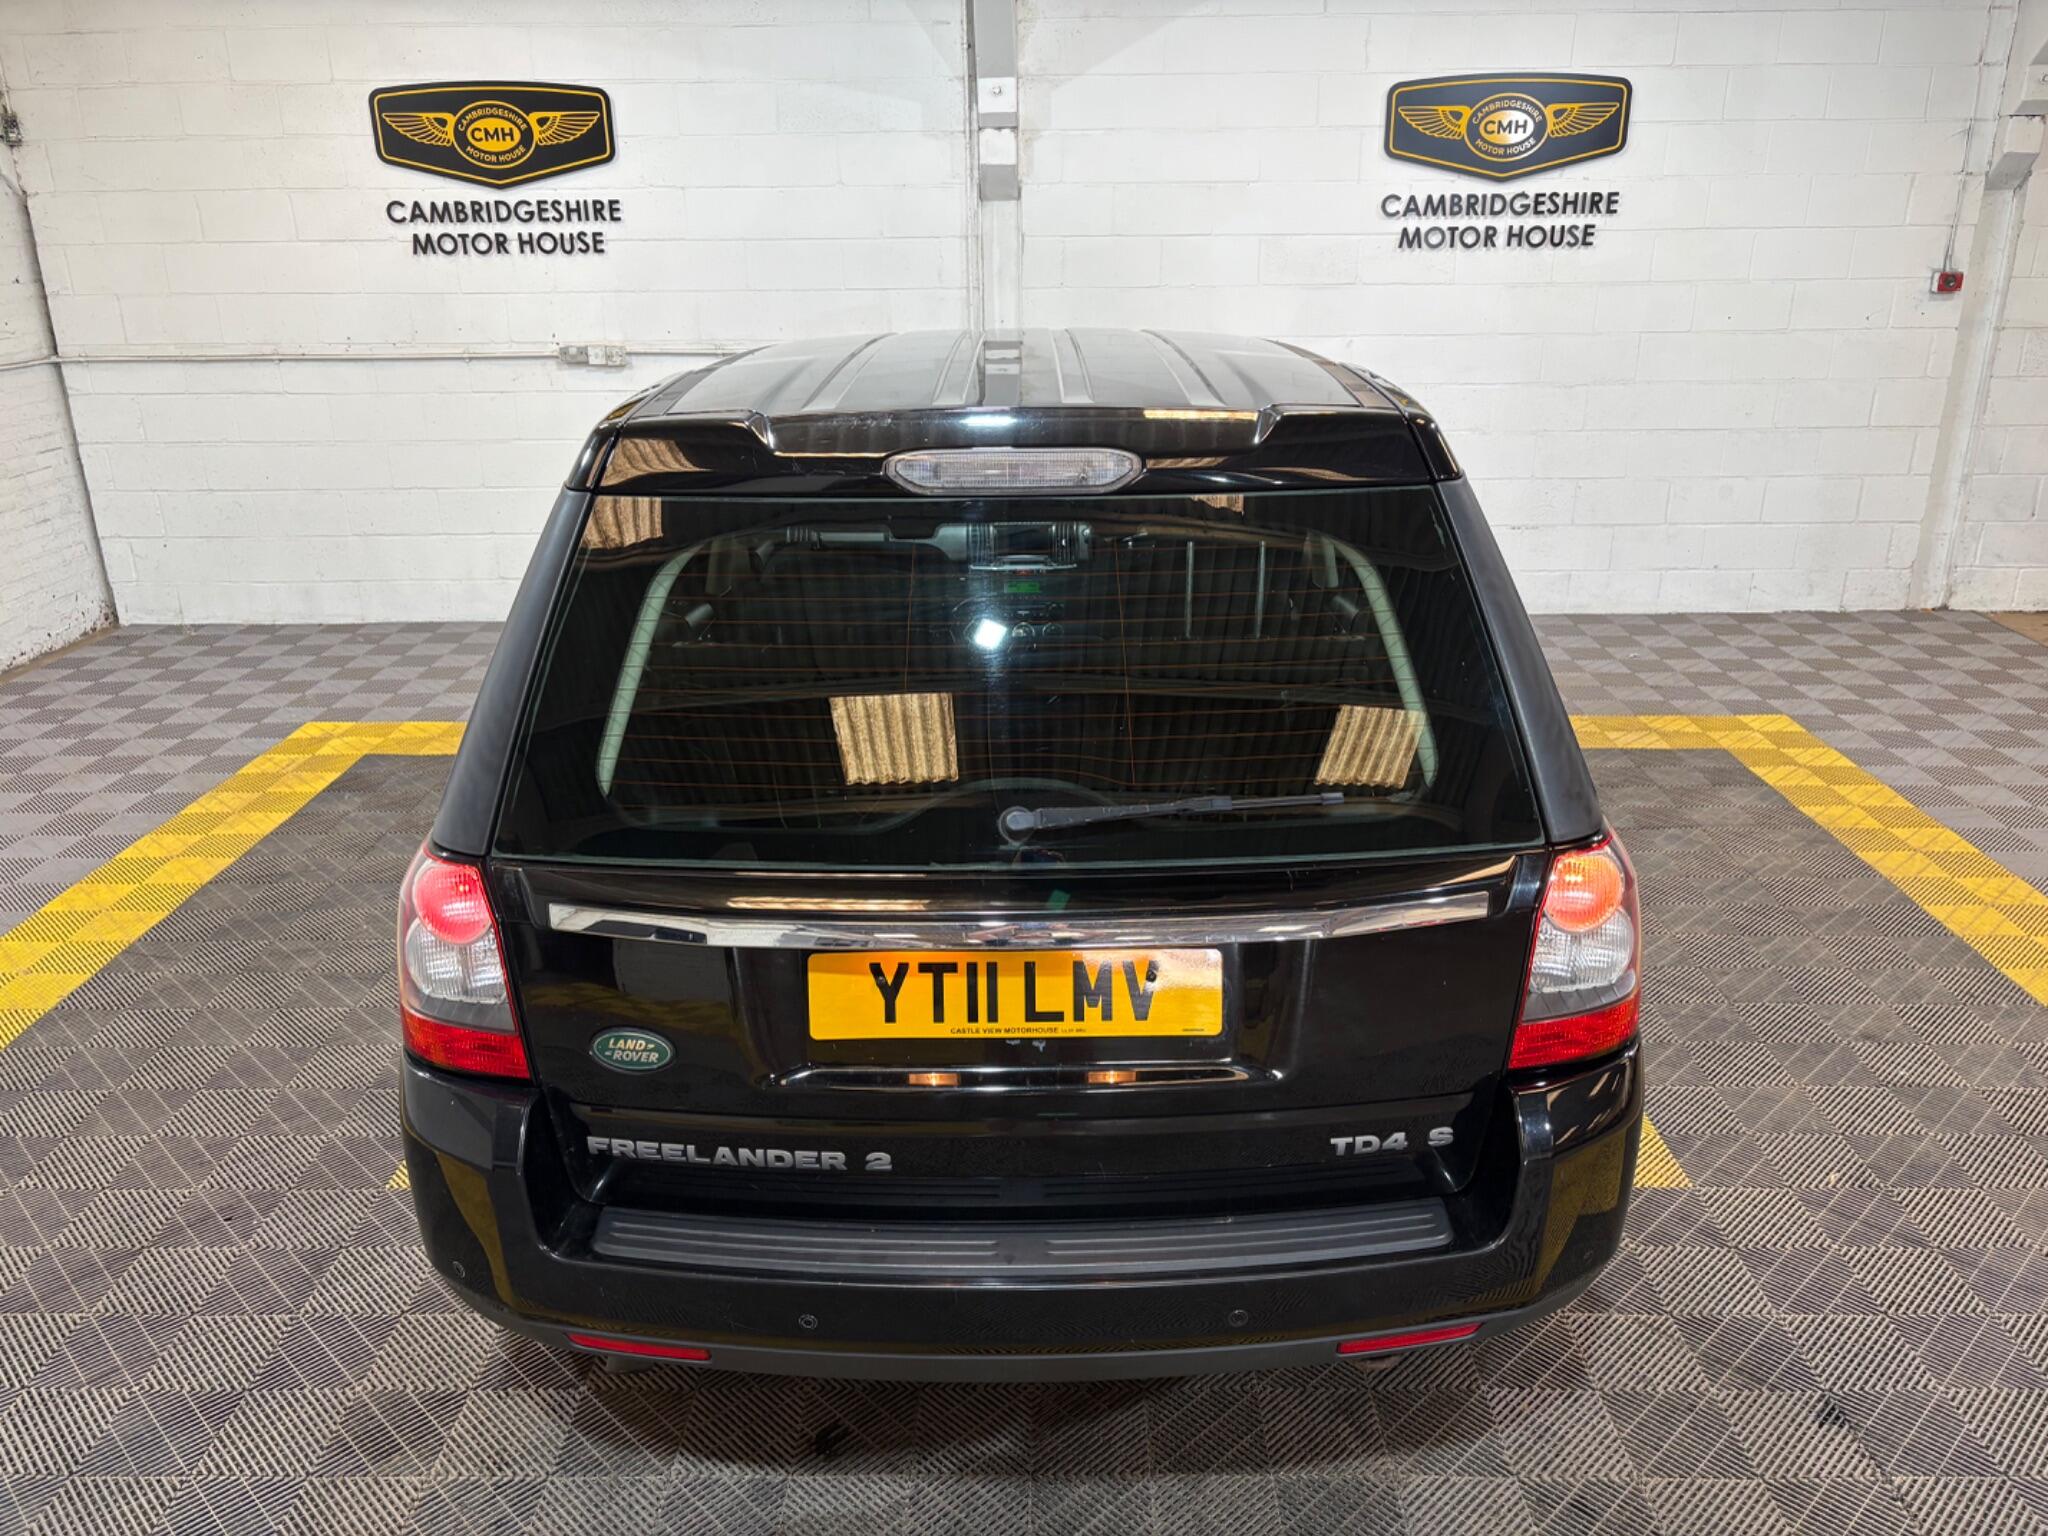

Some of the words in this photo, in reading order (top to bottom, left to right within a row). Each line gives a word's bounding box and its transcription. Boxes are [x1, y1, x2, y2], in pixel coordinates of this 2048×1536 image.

[458, 107, 528, 131] CAMBRIDGESHIRE
[1473, 99, 1542, 124] CAMBRIDGESHIRE
[471, 127, 515, 142] CMH
[1484, 120, 1528, 135] CMH
[466, 145, 497, 163] MOTOR
[498, 144, 526, 163] HOUSE
[1475, 138, 1505, 155] MOTOR
[1506, 136, 1537, 155] HOUSE
[386, 199, 622, 224] CAMBRIDGESHIRE
[1380, 191, 1620, 219] CAMBRIDGESHIRE
[412, 233, 511, 255] MOTOR
[518, 230, 605, 254] HOUSE
[1398, 226, 1497, 249] MOTOR
[1506, 223, 1596, 248] HOUSE
[1024, 960, 1160, 1023] LMV
[950, 1027, 980, 1035] CASTLE
[982, 1027, 1002, 1035] VIEW
[1003, 1026, 1058, 1034] MOTORHOUSE
[587, 1136, 847, 1171] FREELANDER
[865, 1152, 893, 1171] 2
[1330, 1131, 1408, 1156] TD4
[1428, 1126, 1454, 1147] S
